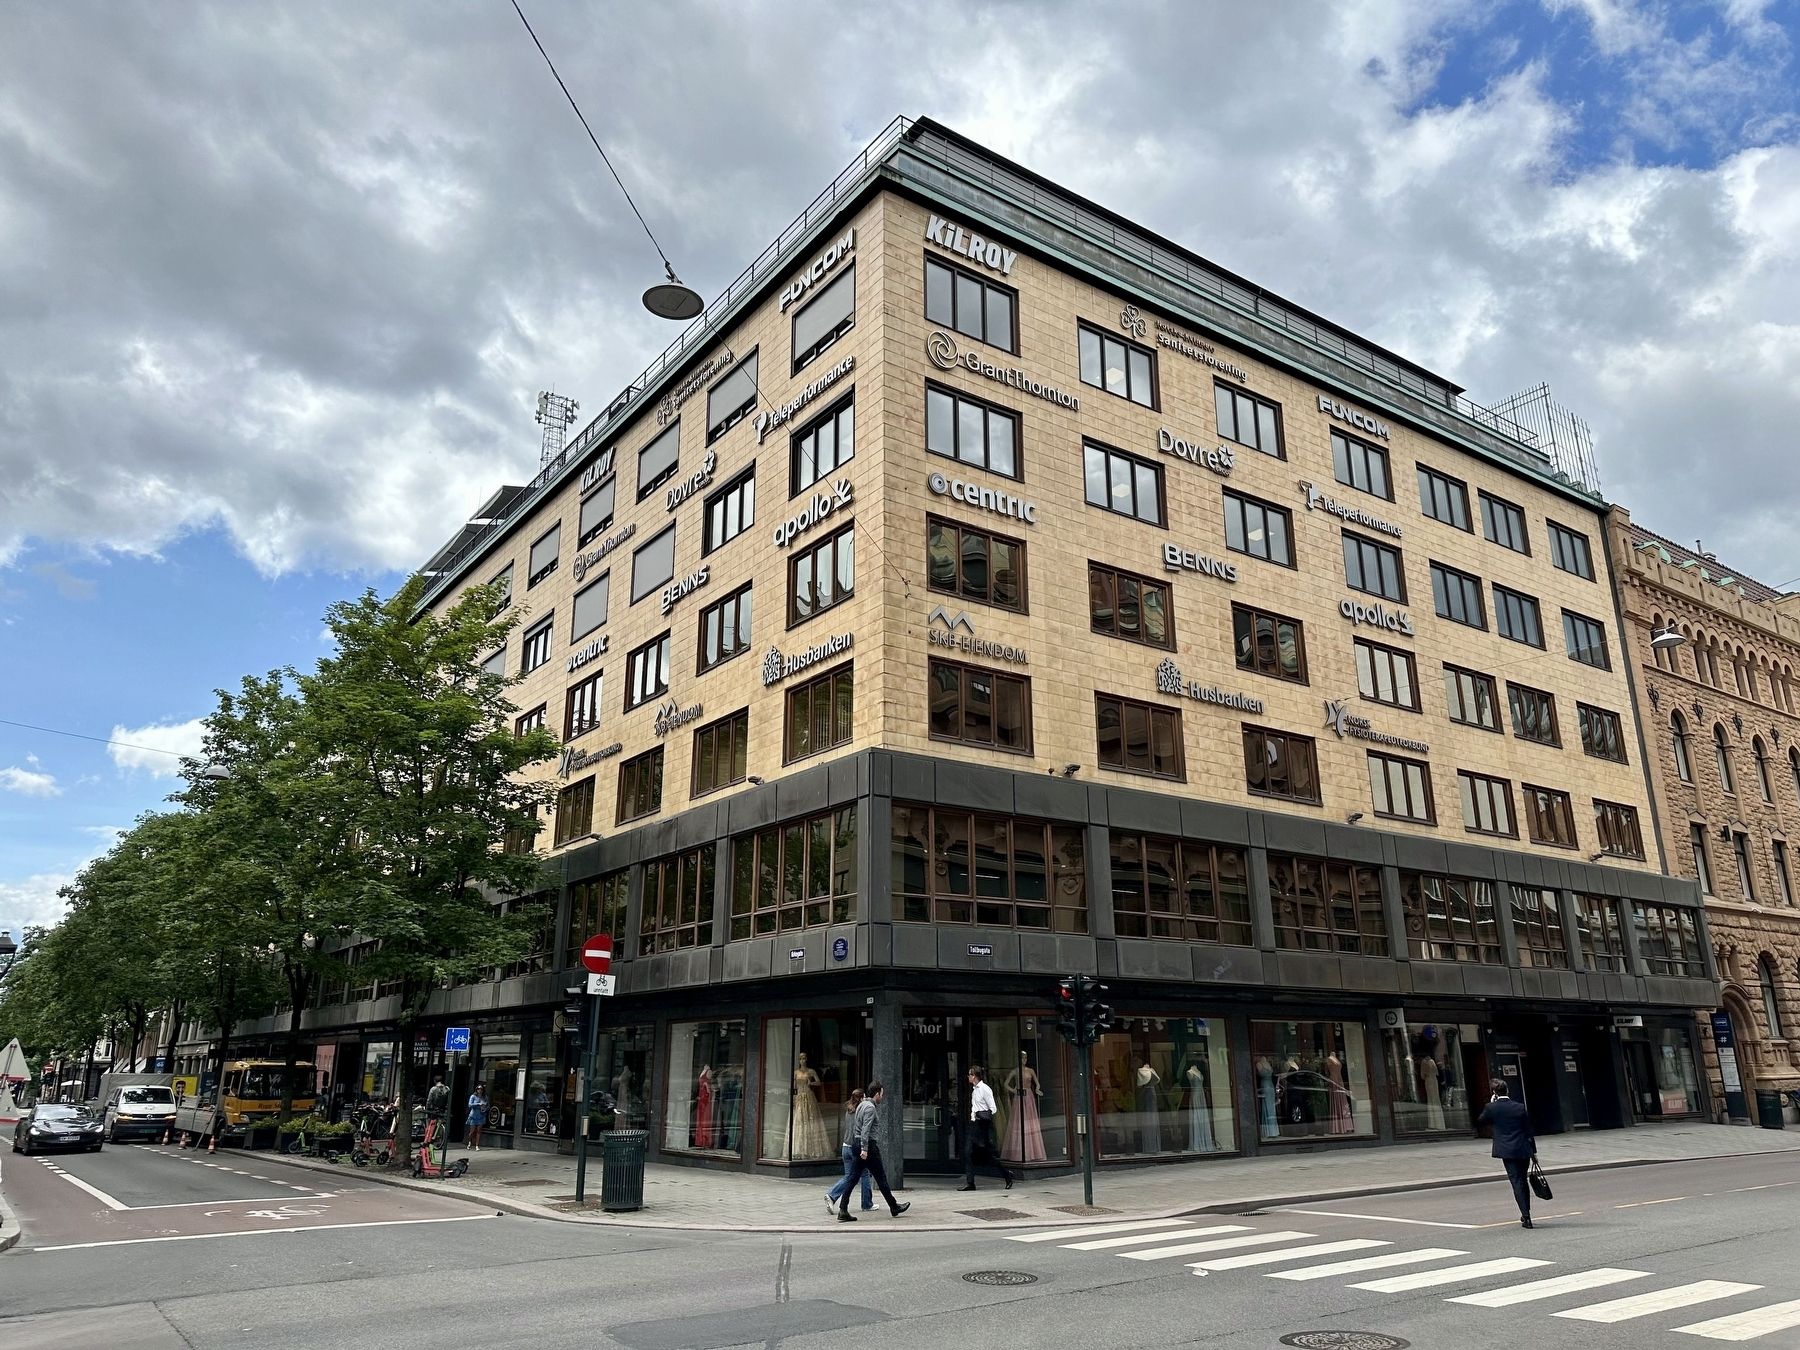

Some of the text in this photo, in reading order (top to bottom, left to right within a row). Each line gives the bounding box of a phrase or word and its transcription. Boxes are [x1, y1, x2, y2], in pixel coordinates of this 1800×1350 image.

[925, 214, 1017, 275] KiLROY
[779, 227, 855, 313] FUNCOM
[1157, 332, 1247, 382] Sanitetsforening
[768, 355, 855, 429] Teleperformance
[1317, 394, 1390, 440] FUNCOM
[1158, 428, 1219, 471] Dovre
[665, 469, 704, 511] Dovre
[950, 478, 1036, 524] centric
[774, 494, 833, 547] apollo
[1322, 495, 1402, 538] Teleperformance
[1163, 543, 1238, 583] BENNS
[661, 565, 710, 614] BENNS
[1339, 599, 1401, 632] apollo
[573, 634, 609, 669] centric
[784, 632, 854, 678] Husbanken
[1187, 681, 1265, 714] Husbanken
